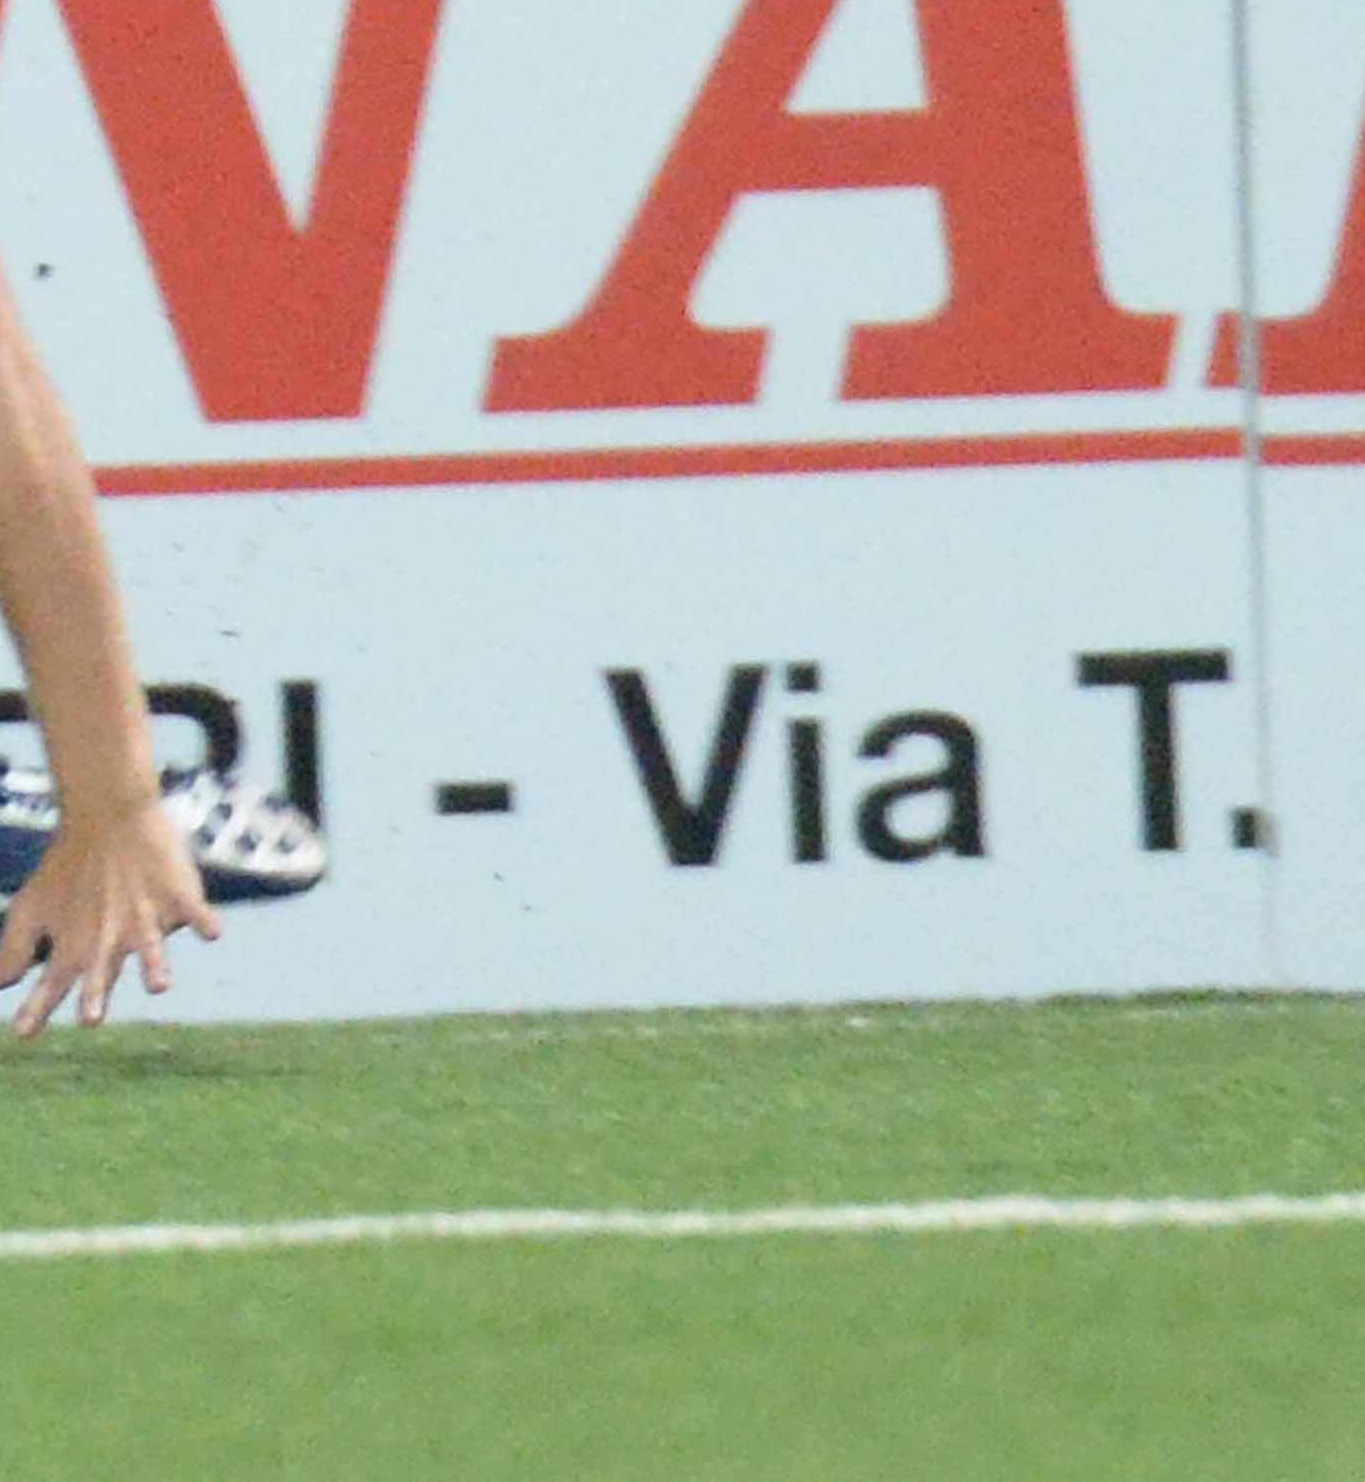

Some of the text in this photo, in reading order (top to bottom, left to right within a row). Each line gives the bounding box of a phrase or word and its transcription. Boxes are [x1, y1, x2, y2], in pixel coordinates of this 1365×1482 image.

[434, 781, 516, 816] -
[602, 659, 991, 868] Via
[1075, 649, 1273, 857] T.
